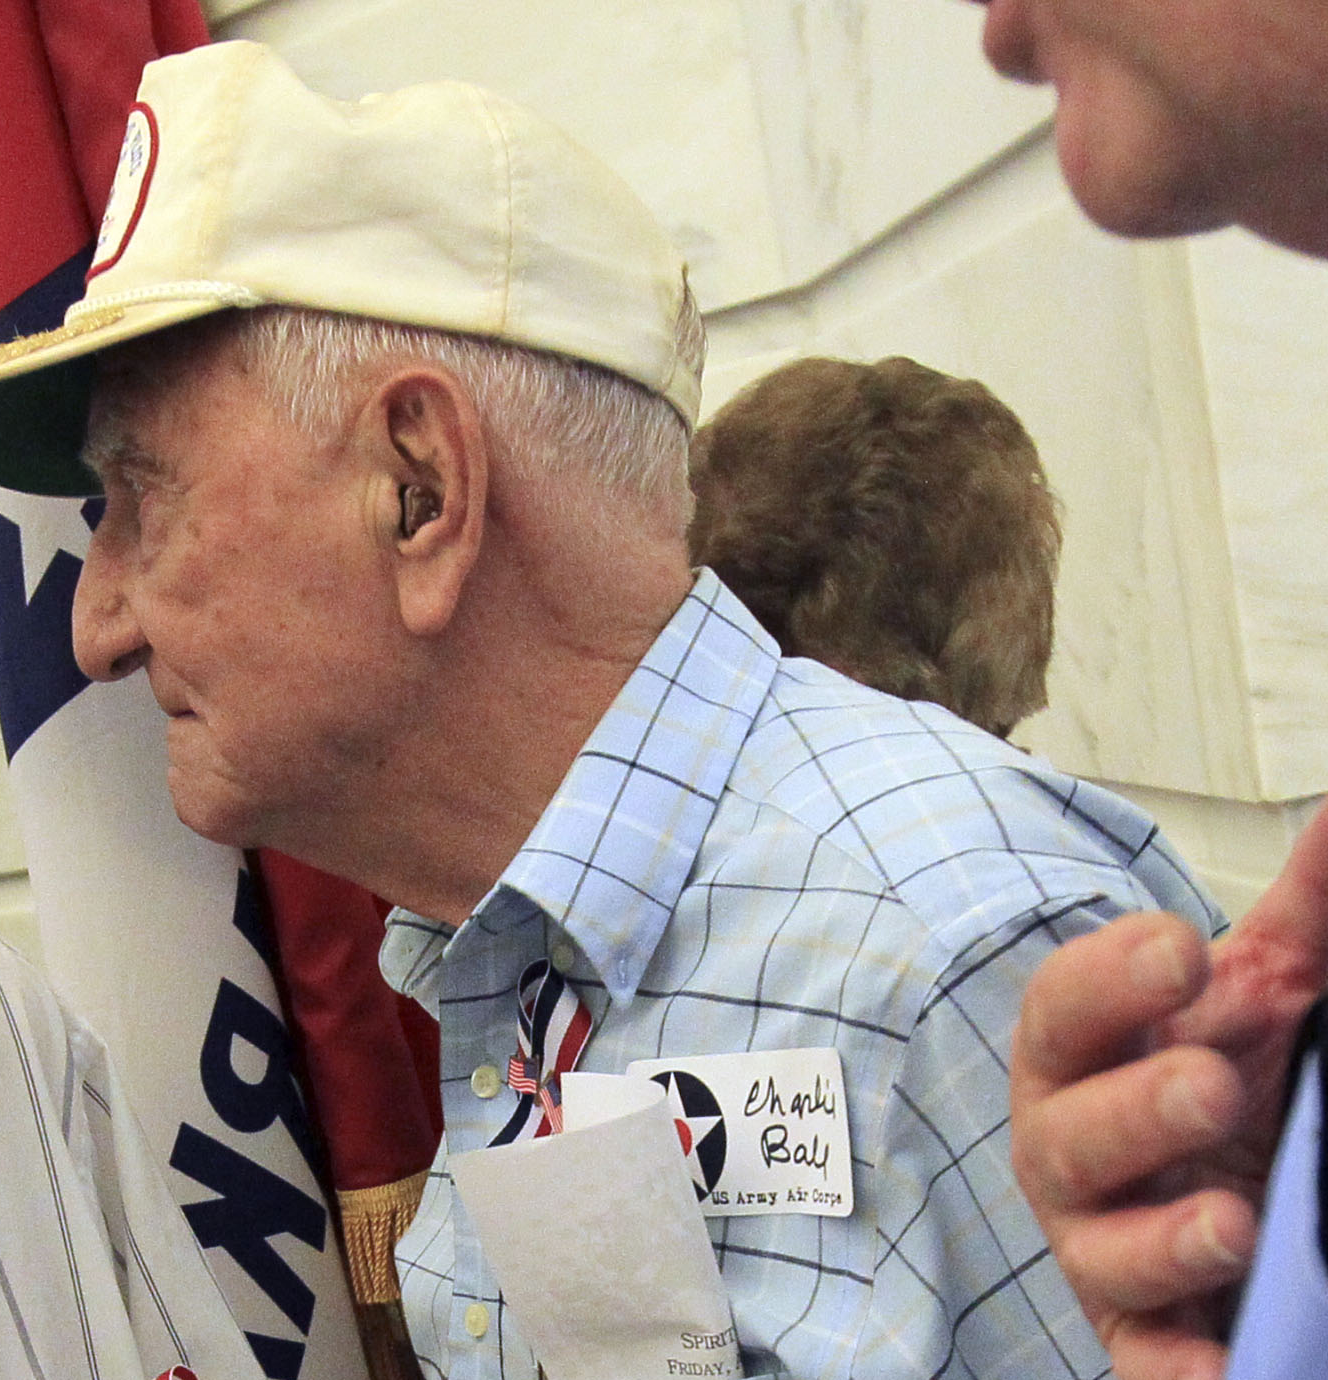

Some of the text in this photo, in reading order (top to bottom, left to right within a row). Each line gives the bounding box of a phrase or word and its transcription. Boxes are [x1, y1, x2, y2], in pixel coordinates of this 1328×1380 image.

[712, 1187, 843, 1206] US Army Air Corps
